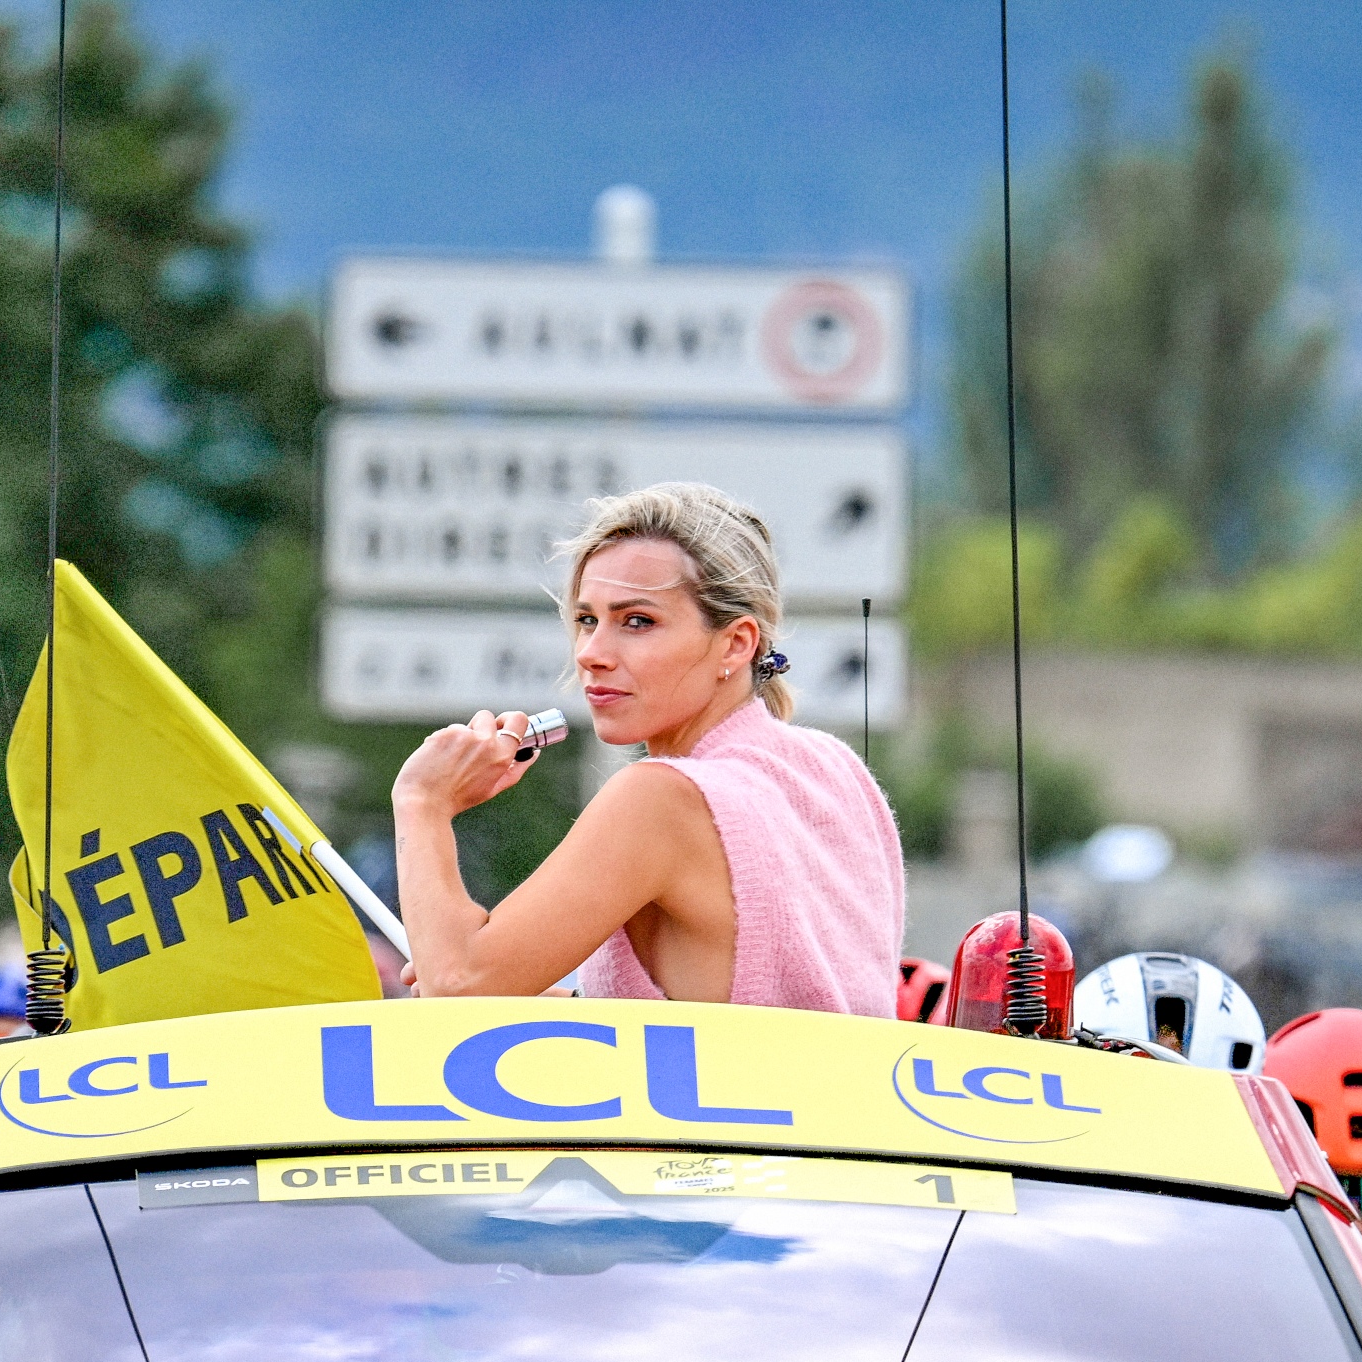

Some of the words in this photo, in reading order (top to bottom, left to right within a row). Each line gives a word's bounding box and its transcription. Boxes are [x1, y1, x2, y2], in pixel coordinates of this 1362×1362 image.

[19, 1052, 208, 1105] LCL
[321, 1020, 794, 1126] LCL
[912, 1057, 1102, 1115] LCL
[280, 1161, 525, 1189] OFFICIEL
[703, 1186, 736, 1194] 2025
[913, 1173, 956, 1205] 1
